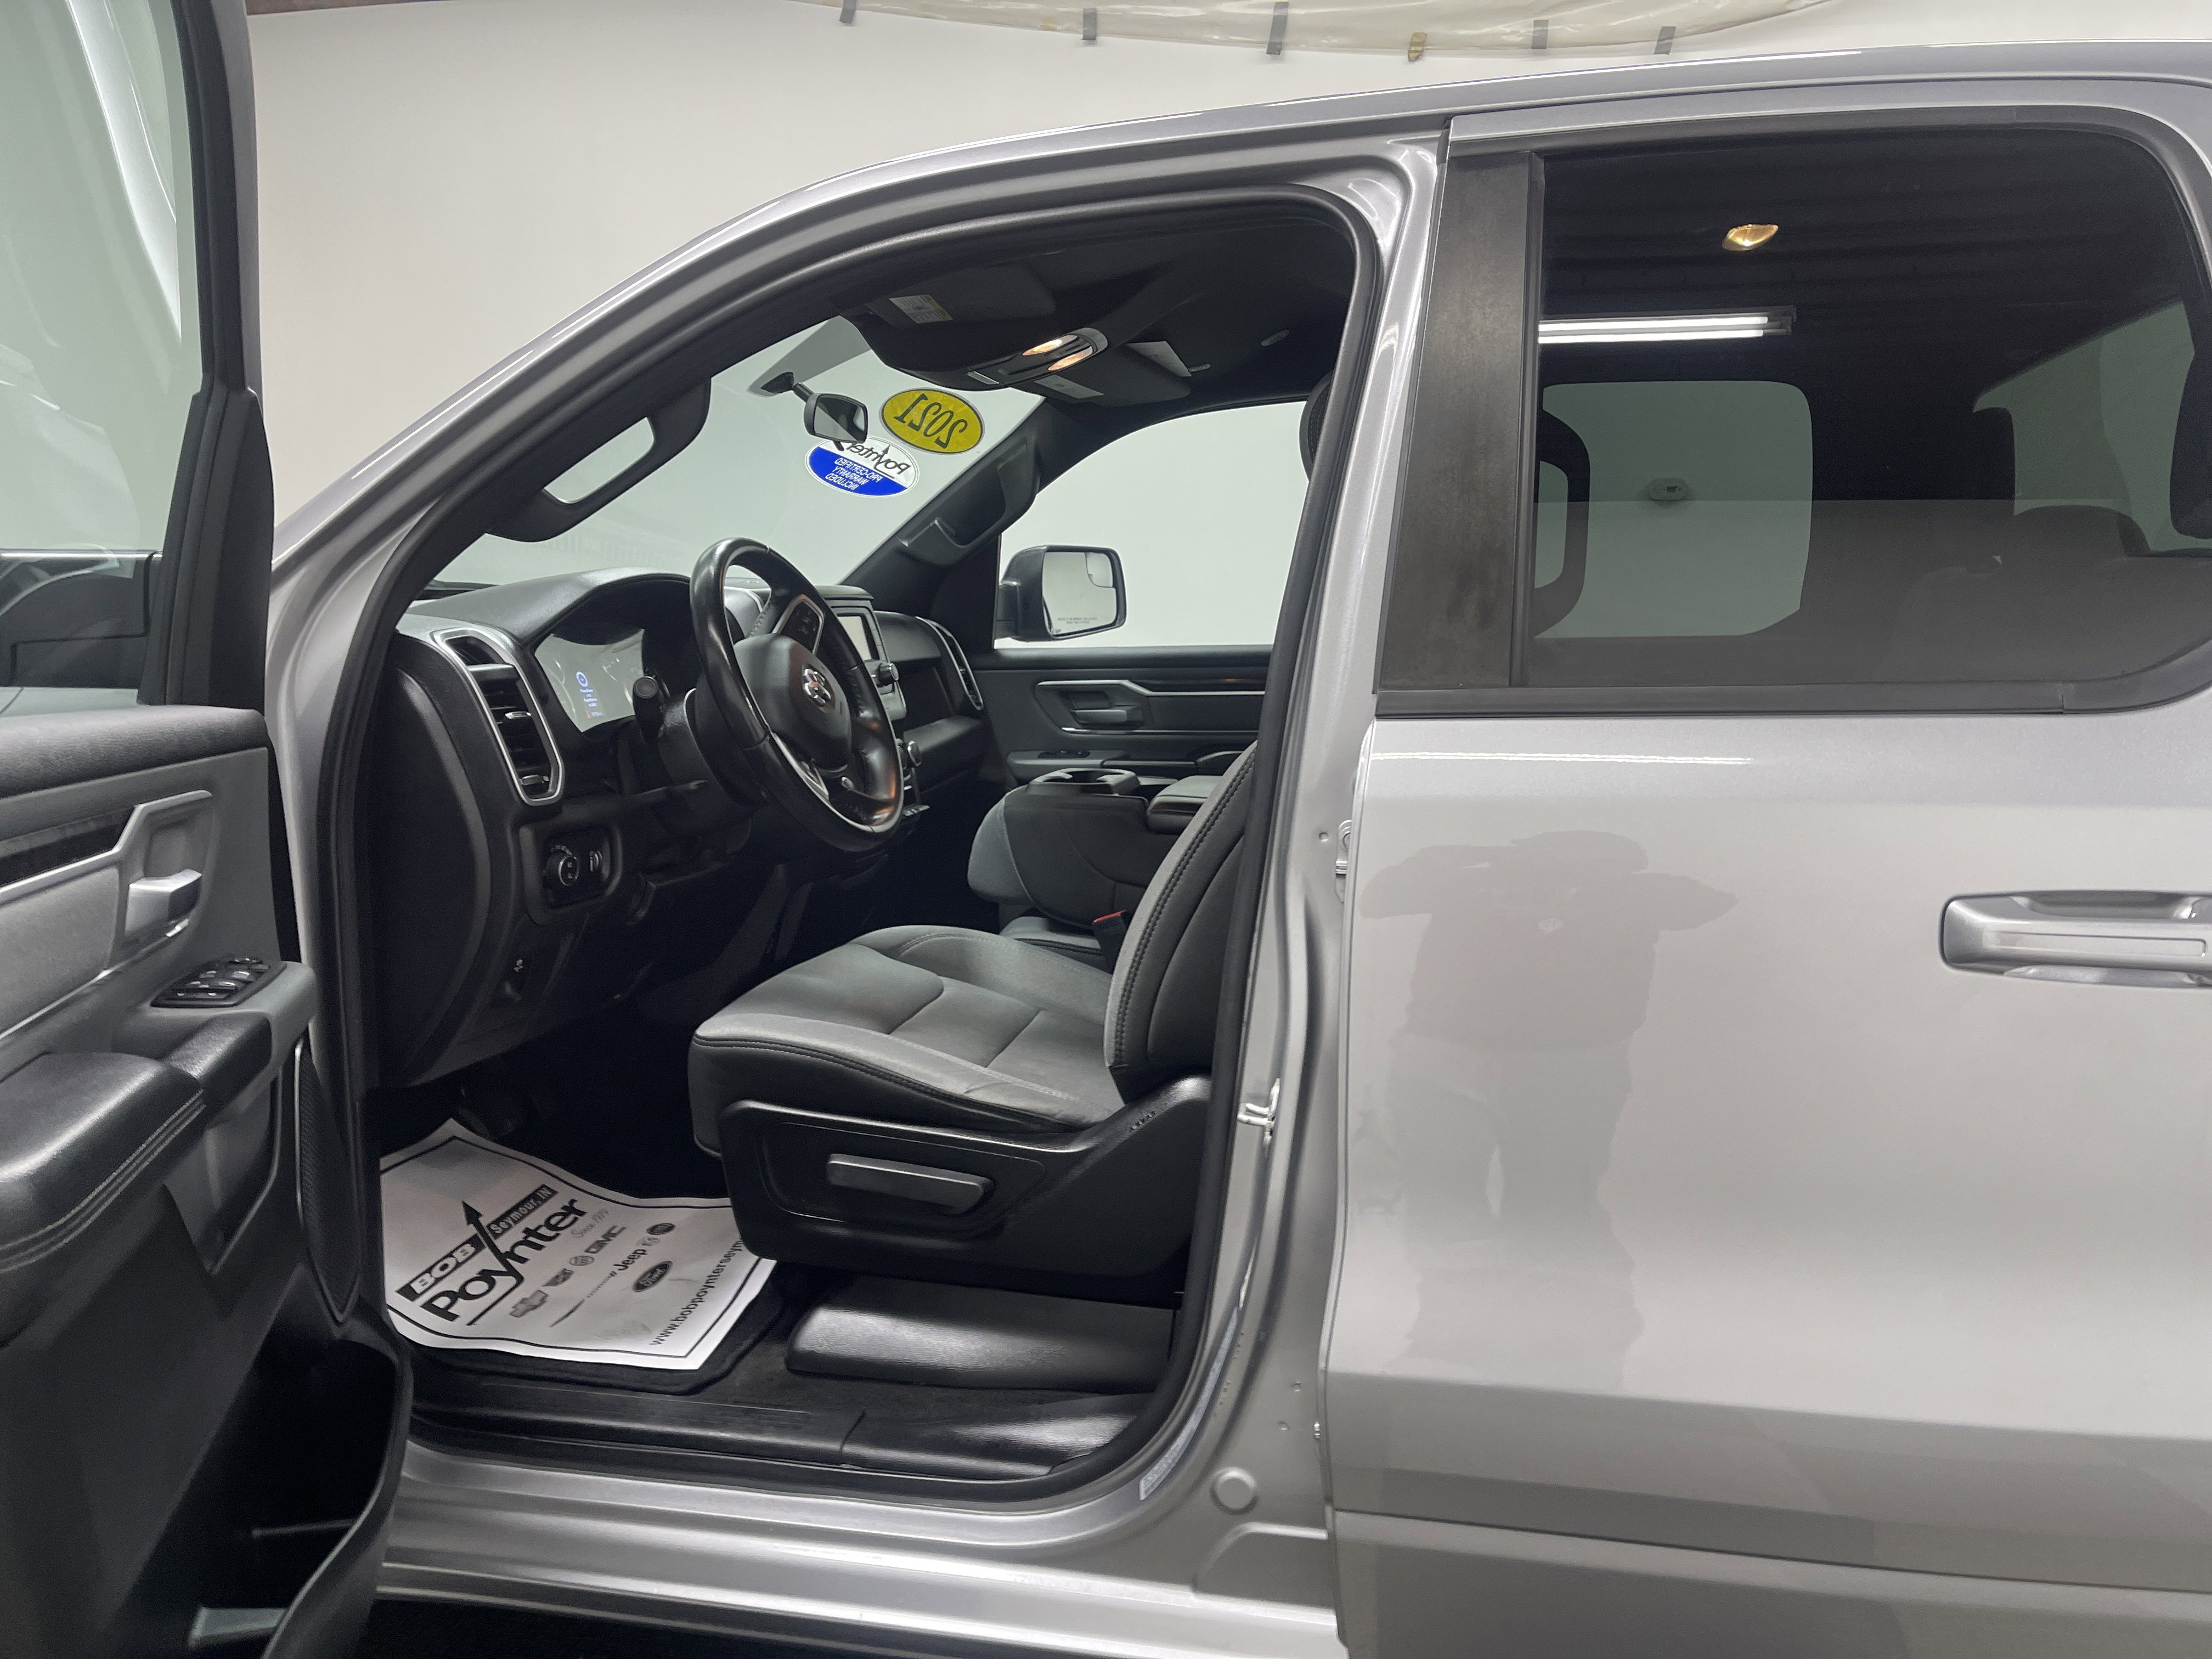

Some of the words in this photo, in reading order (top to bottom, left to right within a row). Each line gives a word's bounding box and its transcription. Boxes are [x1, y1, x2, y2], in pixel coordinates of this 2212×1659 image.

[537, 1186, 553, 1203] IN
[584, 1224, 627, 1254] GMC
[410, 1242, 476, 1295] BOB
[420, 1198, 587, 1322] Poynter
[613, 1249, 648, 1271] Jeep
[648, 1237, 744, 1346] www.bobpoynterseym
